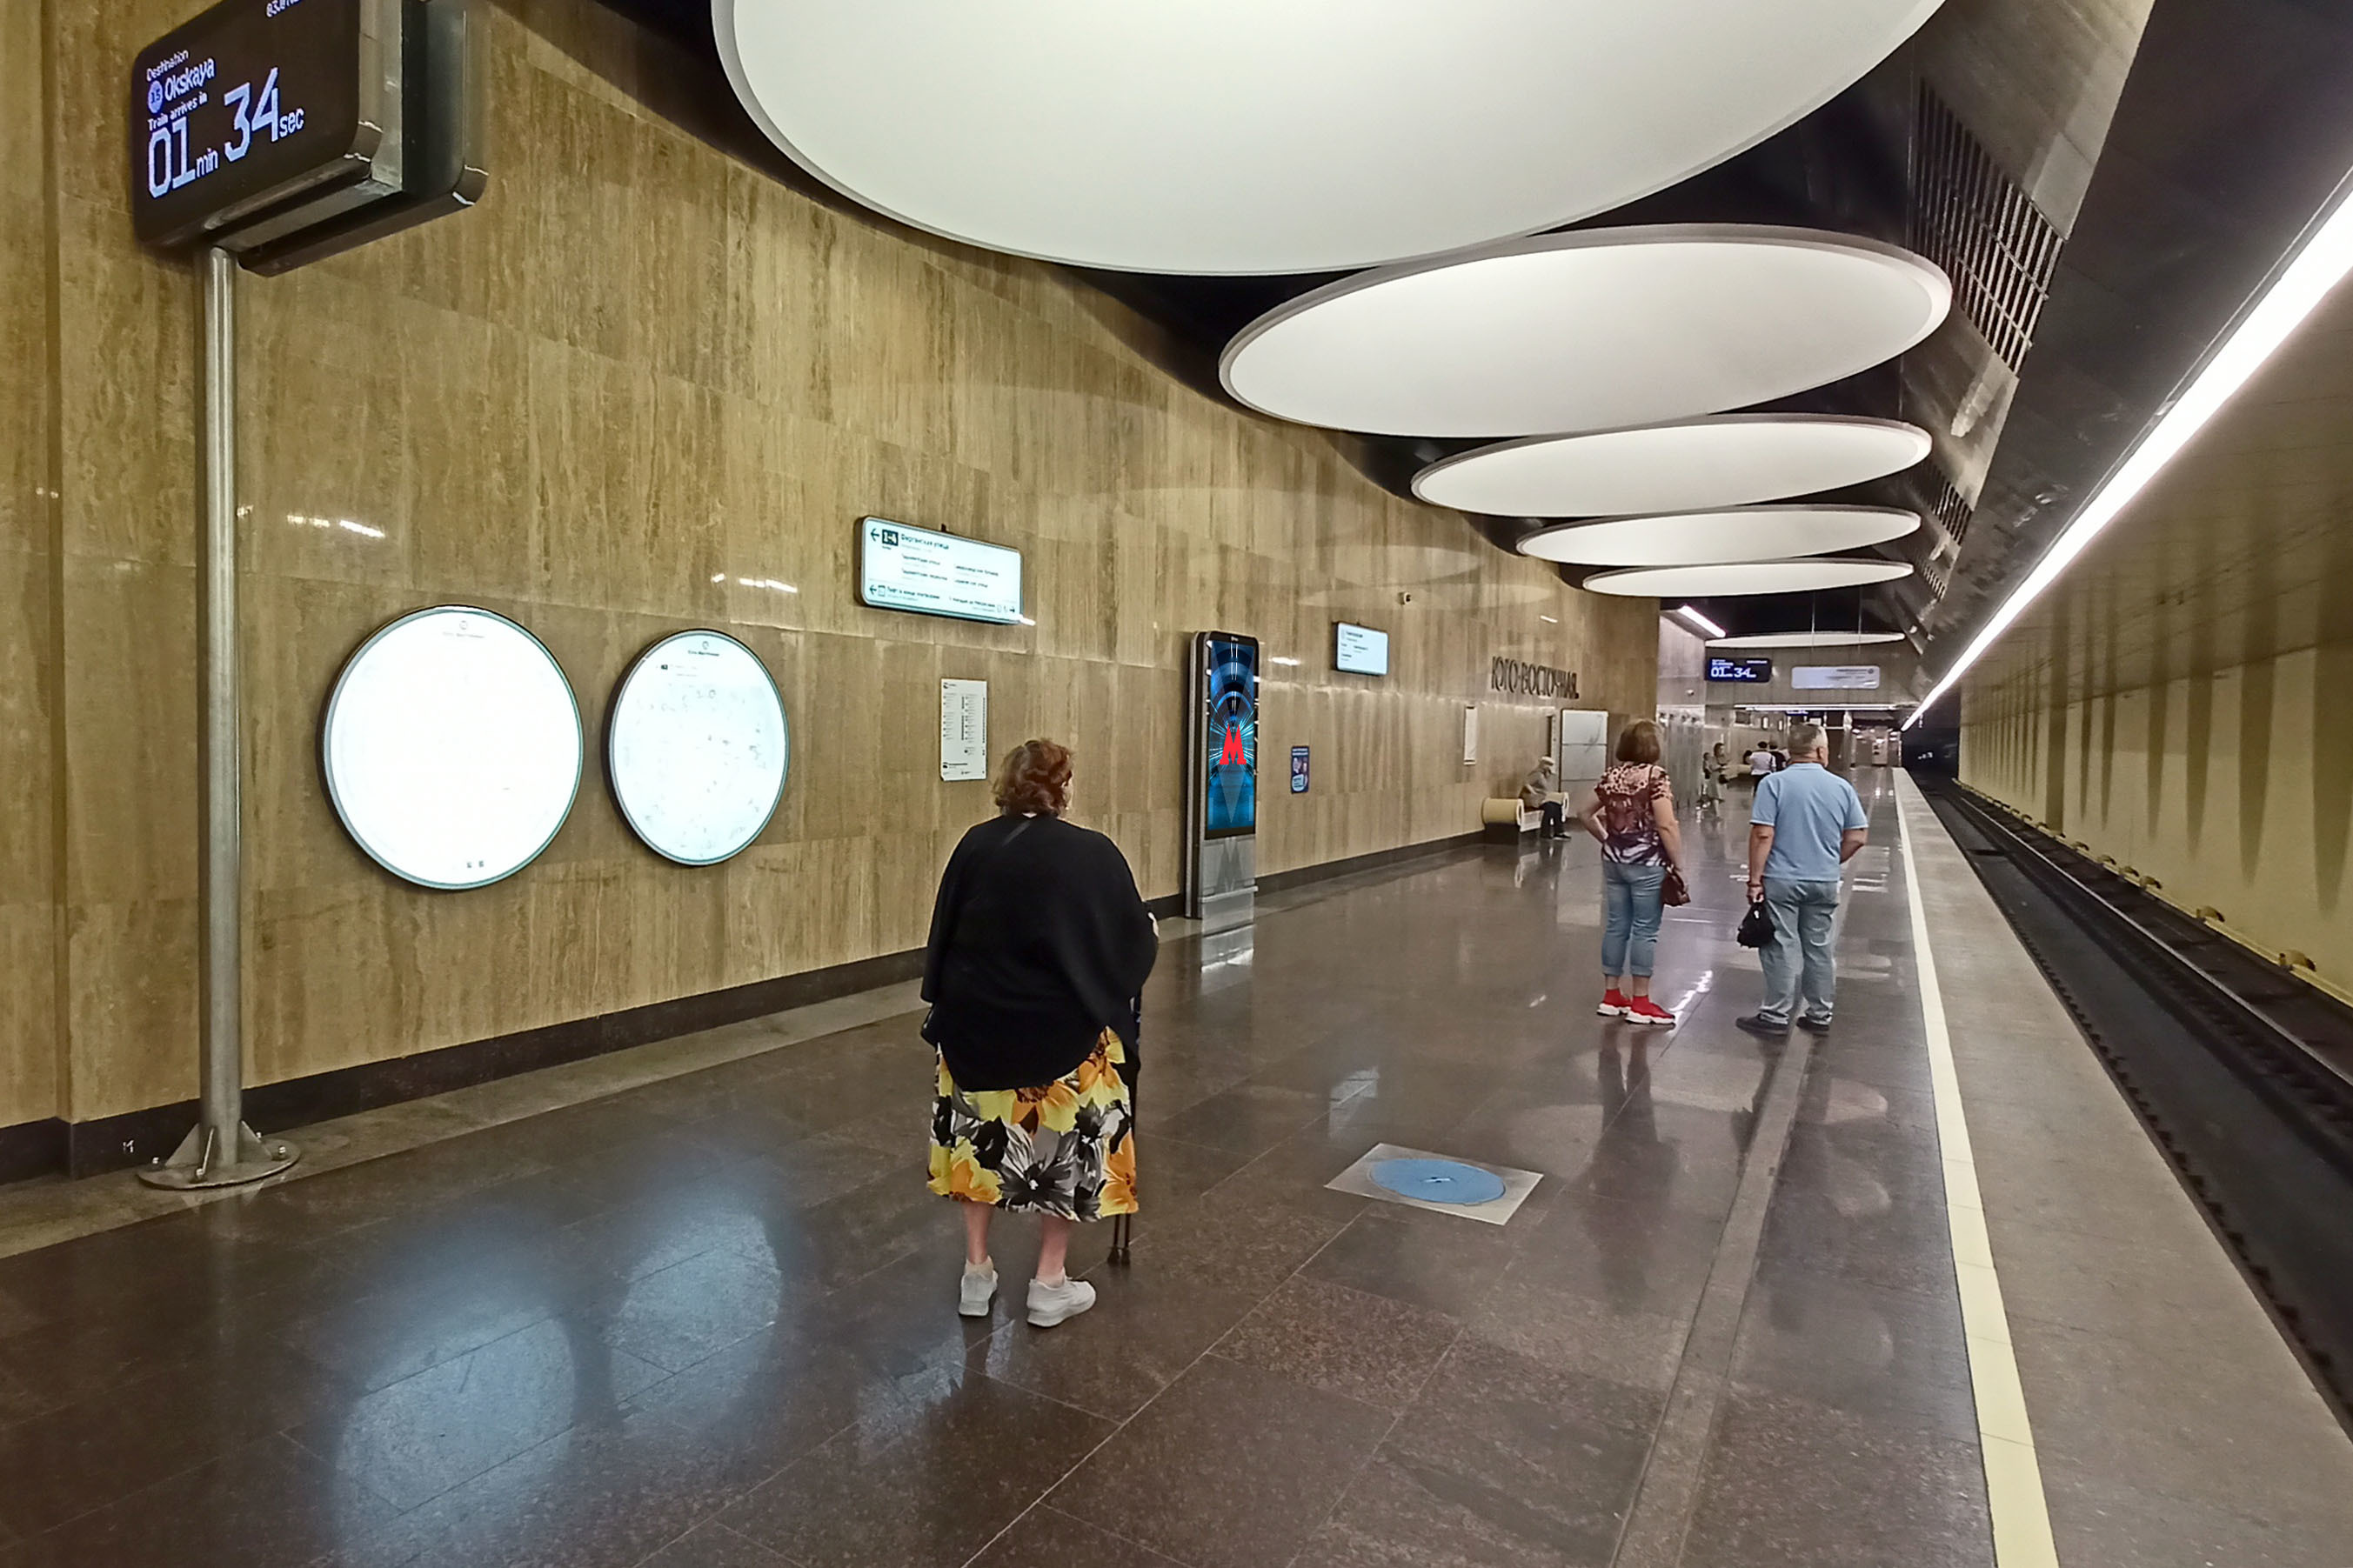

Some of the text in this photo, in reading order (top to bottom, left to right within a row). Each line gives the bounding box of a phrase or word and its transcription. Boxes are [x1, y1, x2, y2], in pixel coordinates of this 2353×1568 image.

[146, 50, 189, 82] Destination
[164, 57, 215, 102] Okskaya
[148, 91, 208, 130] Train arrives in
[148, 67, 304, 198] 01 min 34 sec
